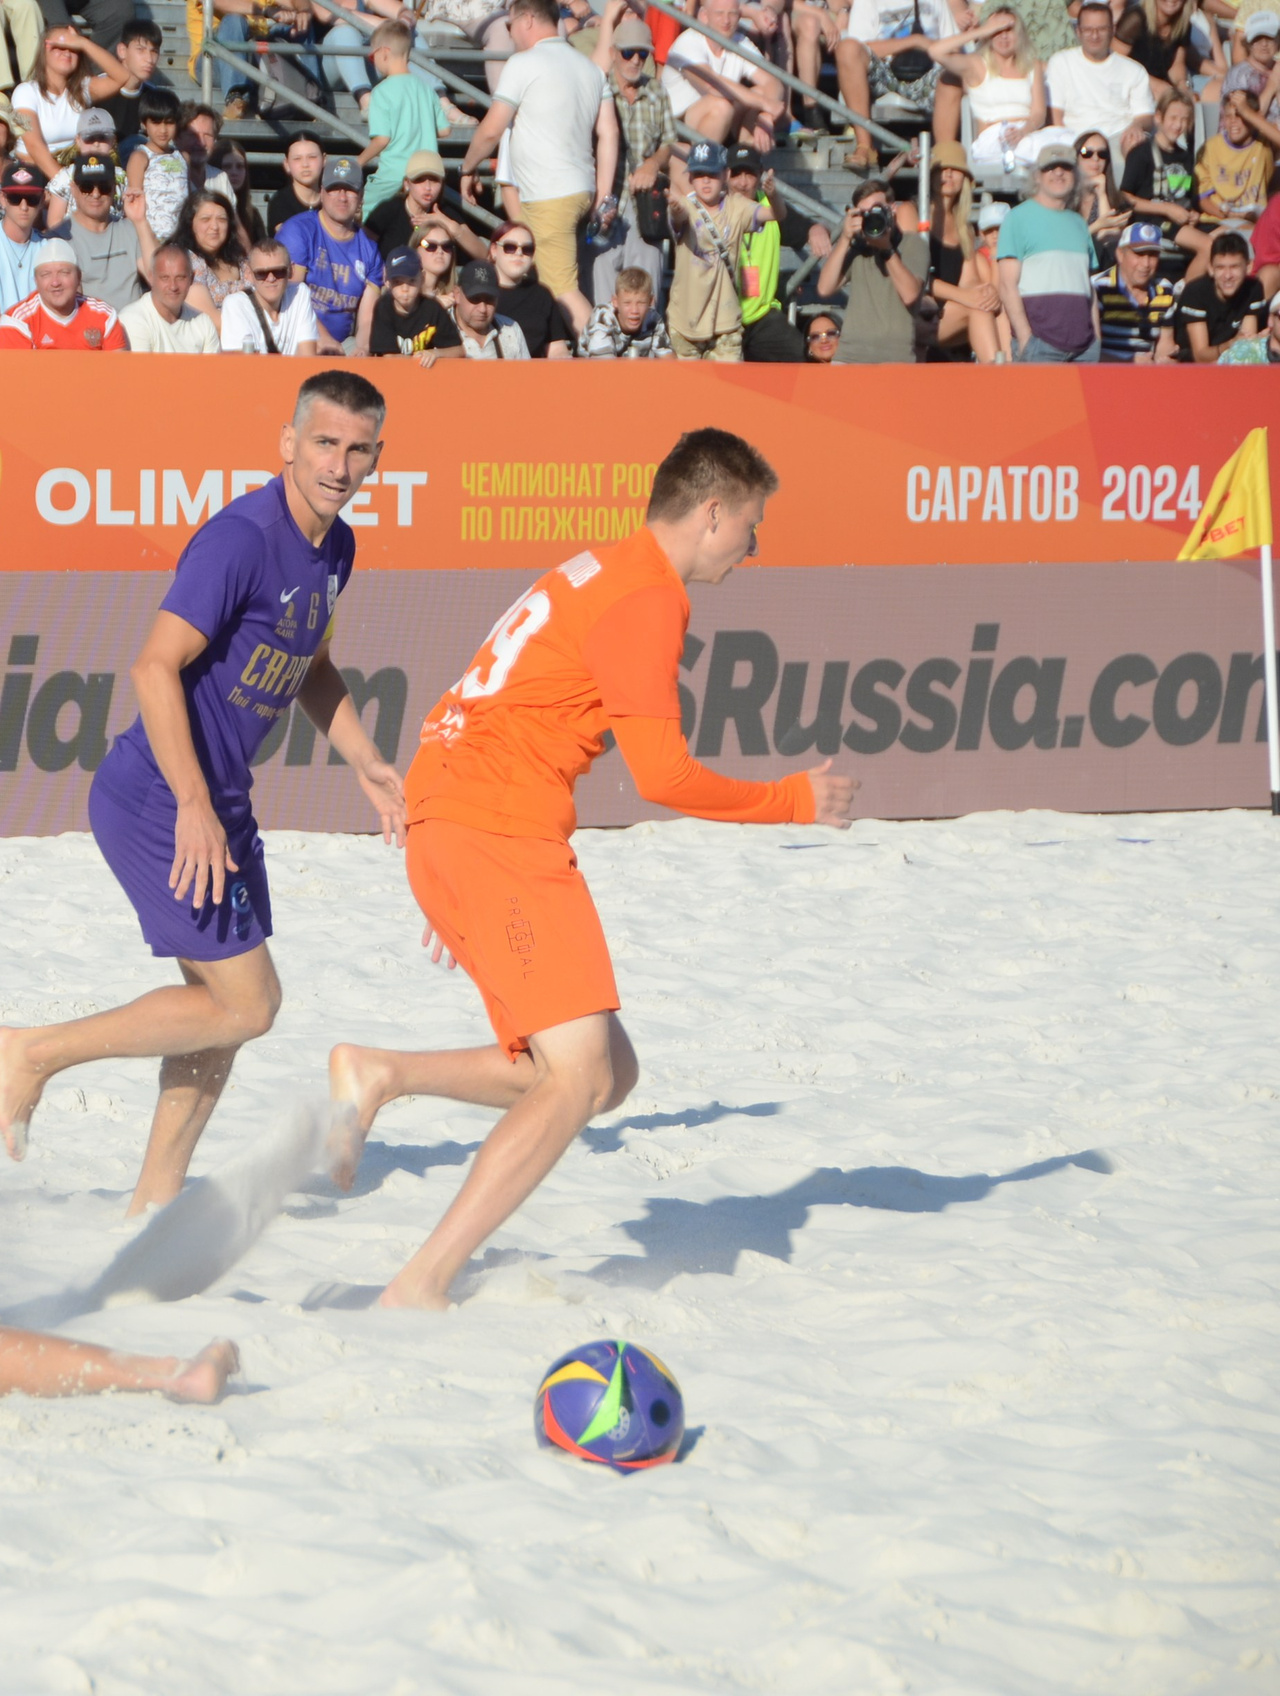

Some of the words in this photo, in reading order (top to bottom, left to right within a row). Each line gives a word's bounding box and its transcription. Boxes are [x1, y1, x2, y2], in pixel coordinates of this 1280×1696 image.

[461, 461, 605, 498] ЧЕМПИОНАТ
[612, 462, 658, 498] РОС
[906, 464, 1079, 523] САРАТОВ
[1101, 464, 1203, 522] 2024
[461, 505, 493, 542] ПО
[500, 506, 646, 542] ПЛЯЖНОМУ
[307, 592, 320, 630] 6
[451, 584, 551, 699] 9
